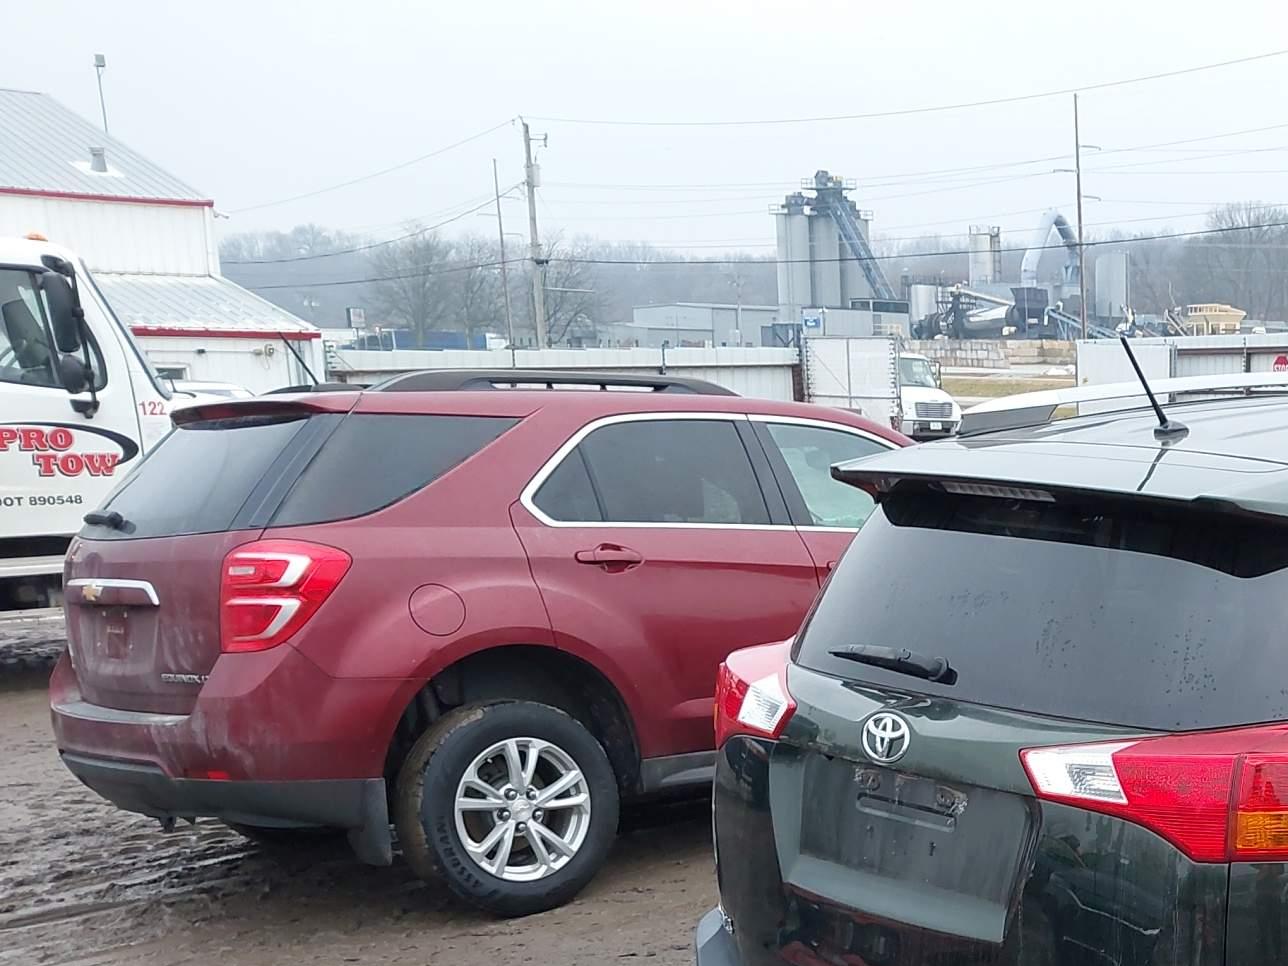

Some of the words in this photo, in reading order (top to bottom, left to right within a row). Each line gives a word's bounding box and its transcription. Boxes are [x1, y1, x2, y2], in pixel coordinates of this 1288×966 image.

[139, 401, 167, 416] 122
[0, 428, 74, 451] PRO
[34, 453, 120, 477] TOW
[0, 496, 24, 507] OT
[29, 495, 83, 506] 890548
